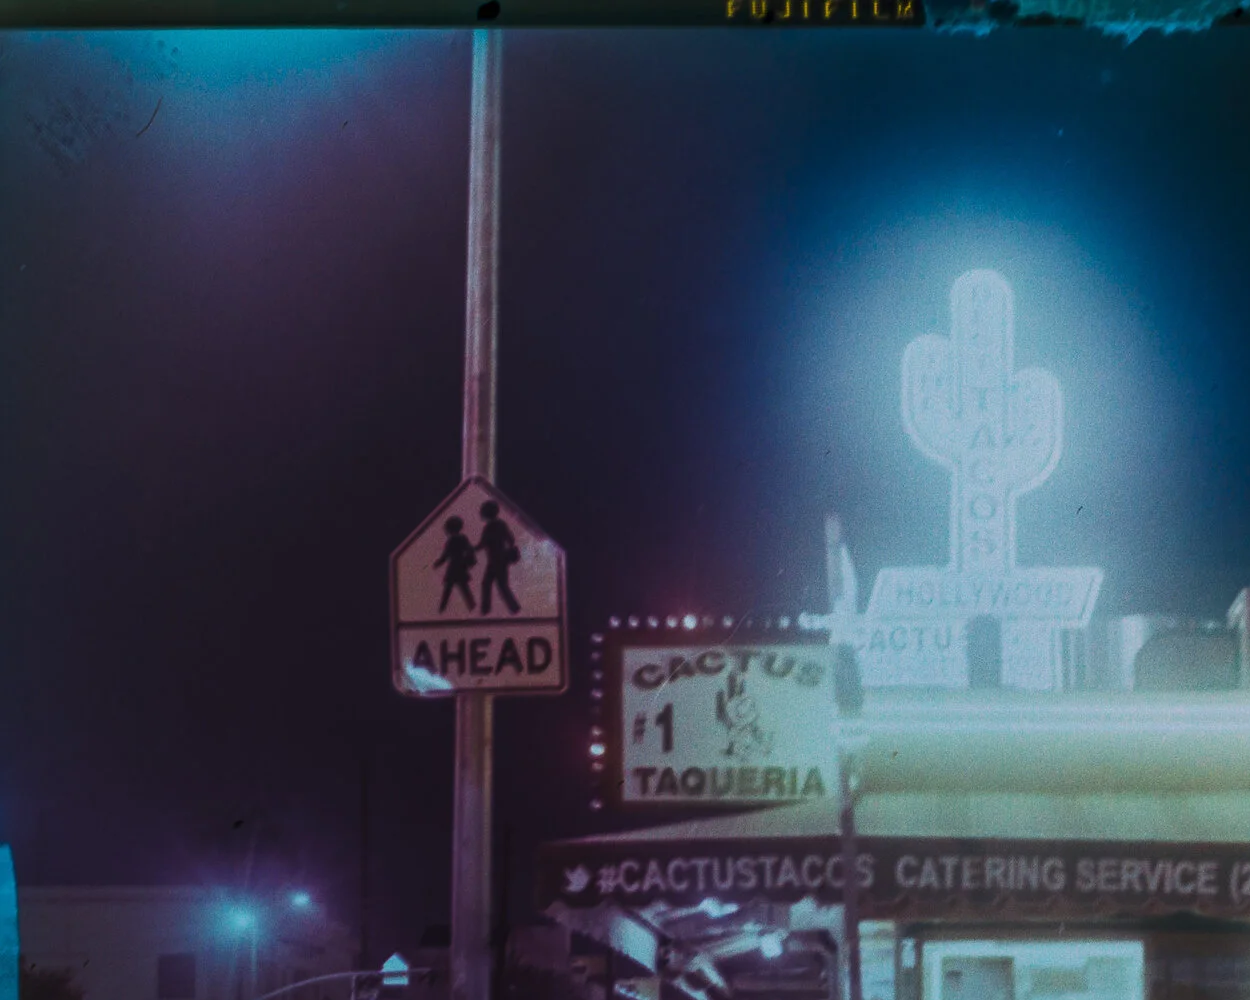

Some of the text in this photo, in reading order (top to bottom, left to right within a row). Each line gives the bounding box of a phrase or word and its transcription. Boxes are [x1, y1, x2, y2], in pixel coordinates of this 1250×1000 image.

[968, 388, 998, 560] TACOS
[896, 580, 1075, 608] HOLLYWOOD
[412, 635, 553, 676] AHEAD
[631, 650, 825, 691] CACTUS
[632, 702, 674, 754] #1
[632, 766, 826, 796] TAQUERIA
[598, 855, 875, 893] #CACTUSTACOS
[895, 856, 1067, 891] CATERING
[1075, 858, 1218, 894] SERVICE
